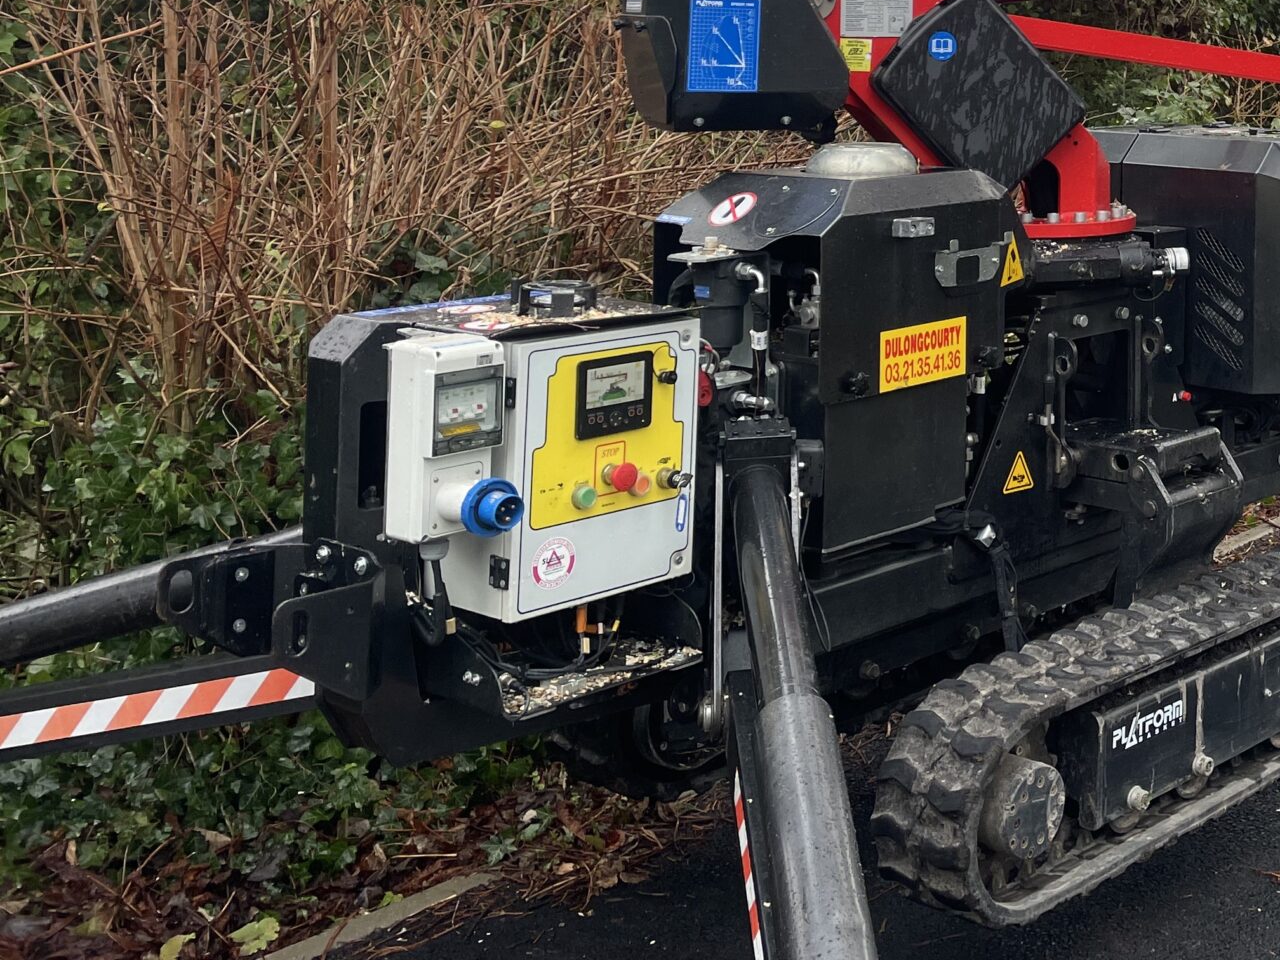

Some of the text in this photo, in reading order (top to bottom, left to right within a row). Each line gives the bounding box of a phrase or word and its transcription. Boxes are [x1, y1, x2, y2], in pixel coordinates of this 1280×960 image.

[885, 325, 961, 359] DULONGCOURTY
[885, 349, 960, 384] 03.21.35.41.36
[1172, 392, 1178, 402] A
[601, 447, 620, 458] STOP
[1112, 700, 1183, 750] PLATFORM
